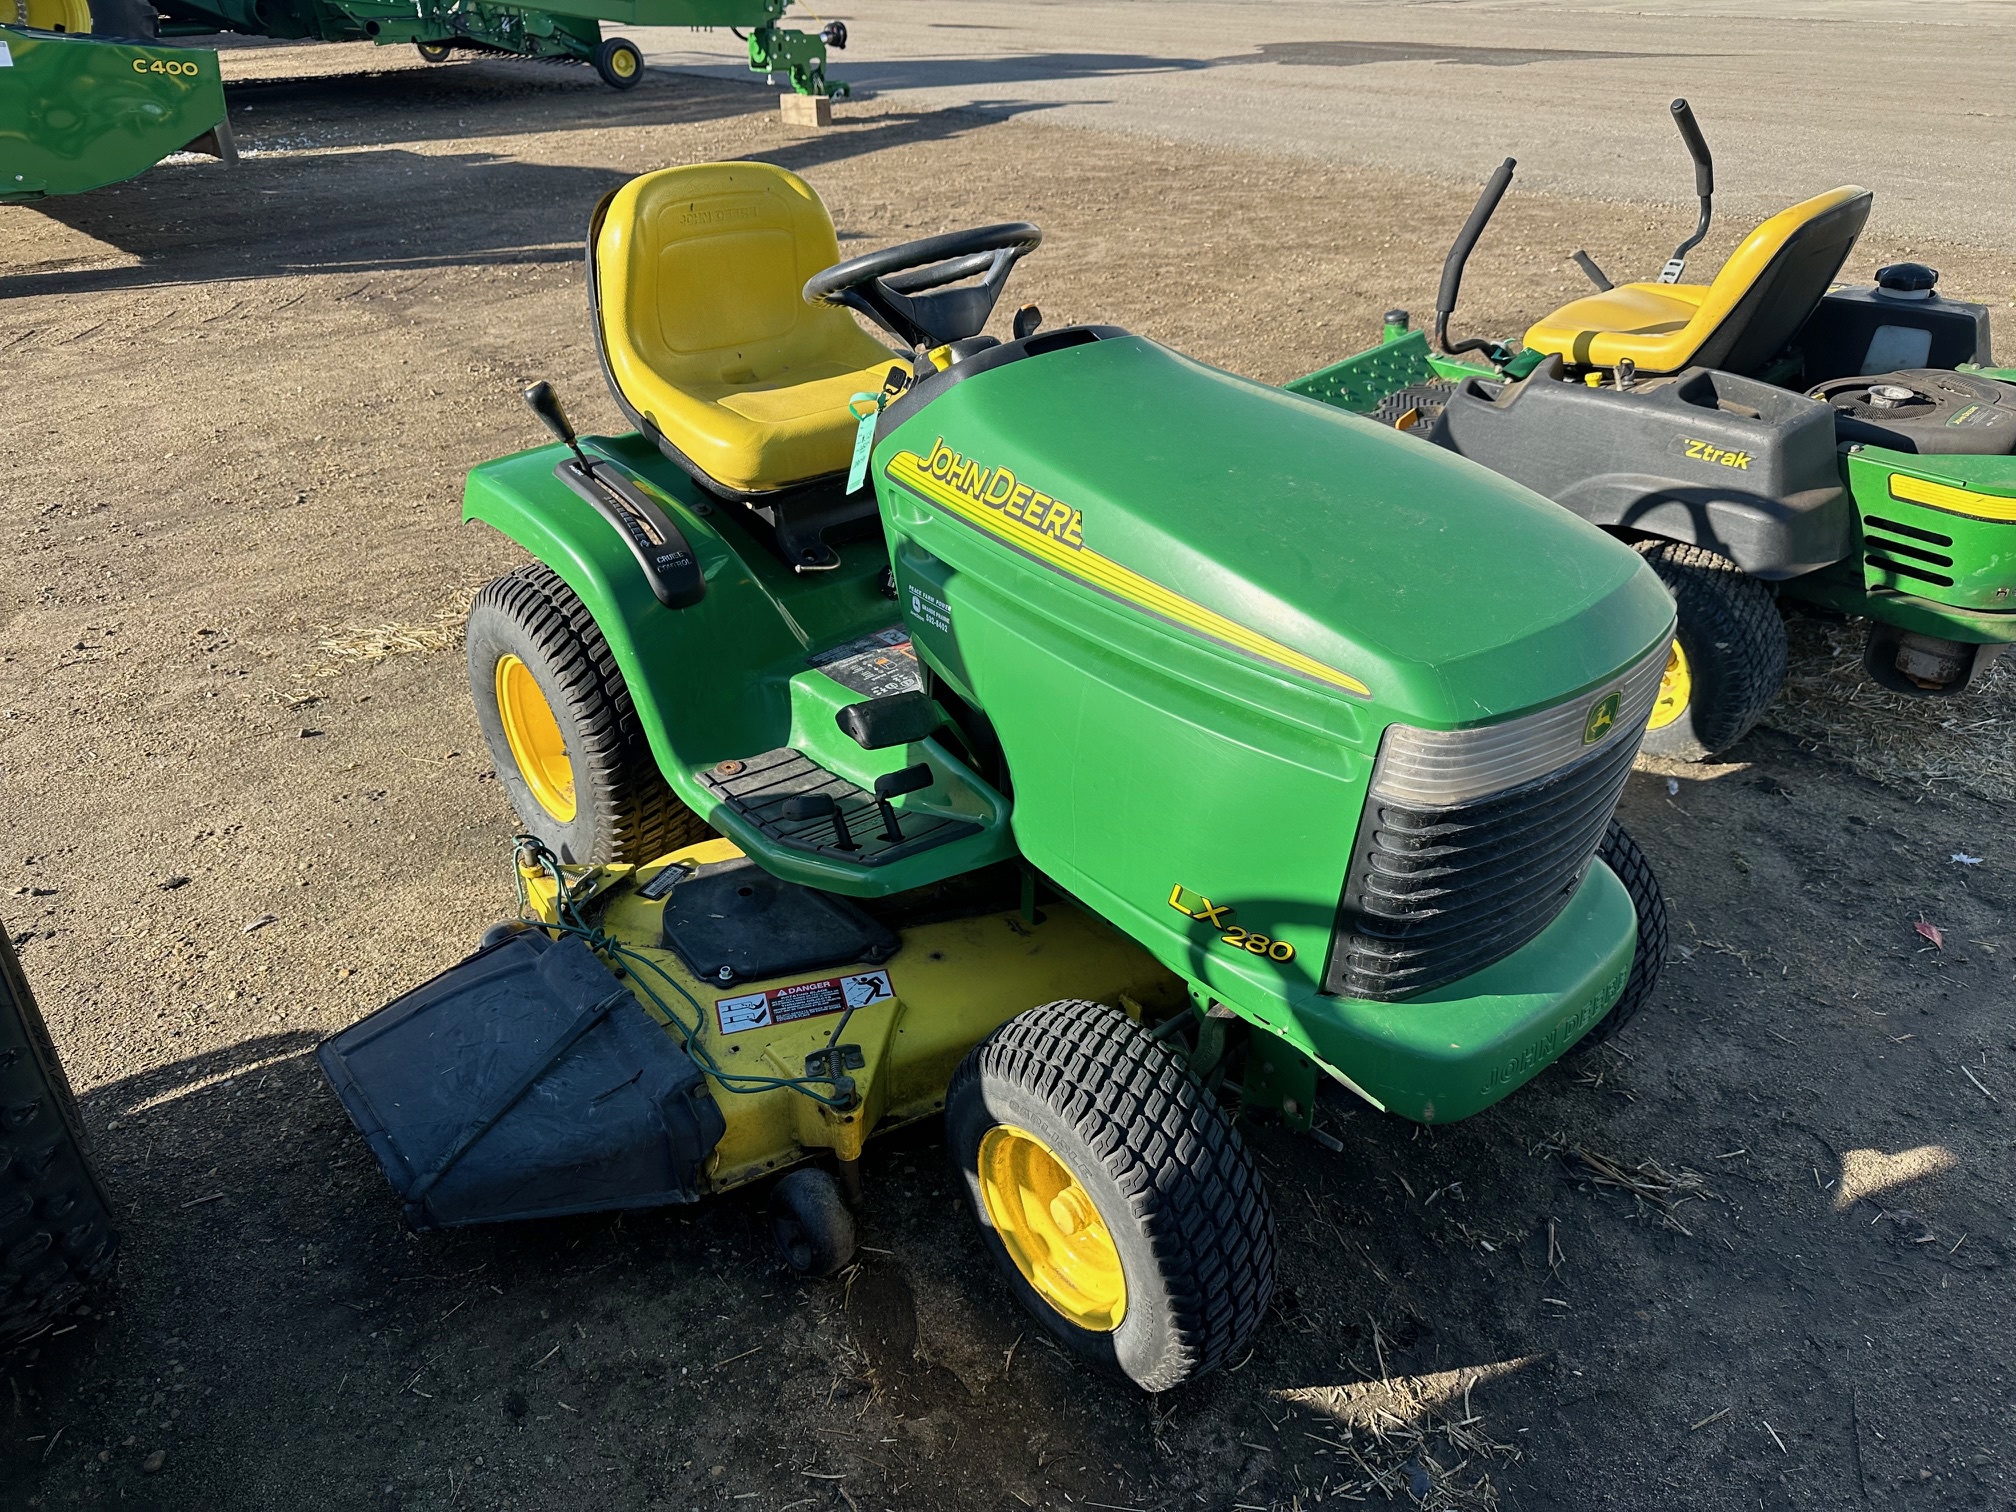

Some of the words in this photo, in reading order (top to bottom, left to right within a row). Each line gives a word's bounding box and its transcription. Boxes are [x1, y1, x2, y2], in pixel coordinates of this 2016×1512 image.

[1684, 439, 1752, 470] Ztrak
[656, 551, 685, 564] CRUISE
[788, 981, 831, 995] DANGER
[1481, 1028, 1557, 1095] JOHN
[1563, 963, 1628, 1043] DEERE
[1009, 1100, 1093, 1178] CARLISLE
